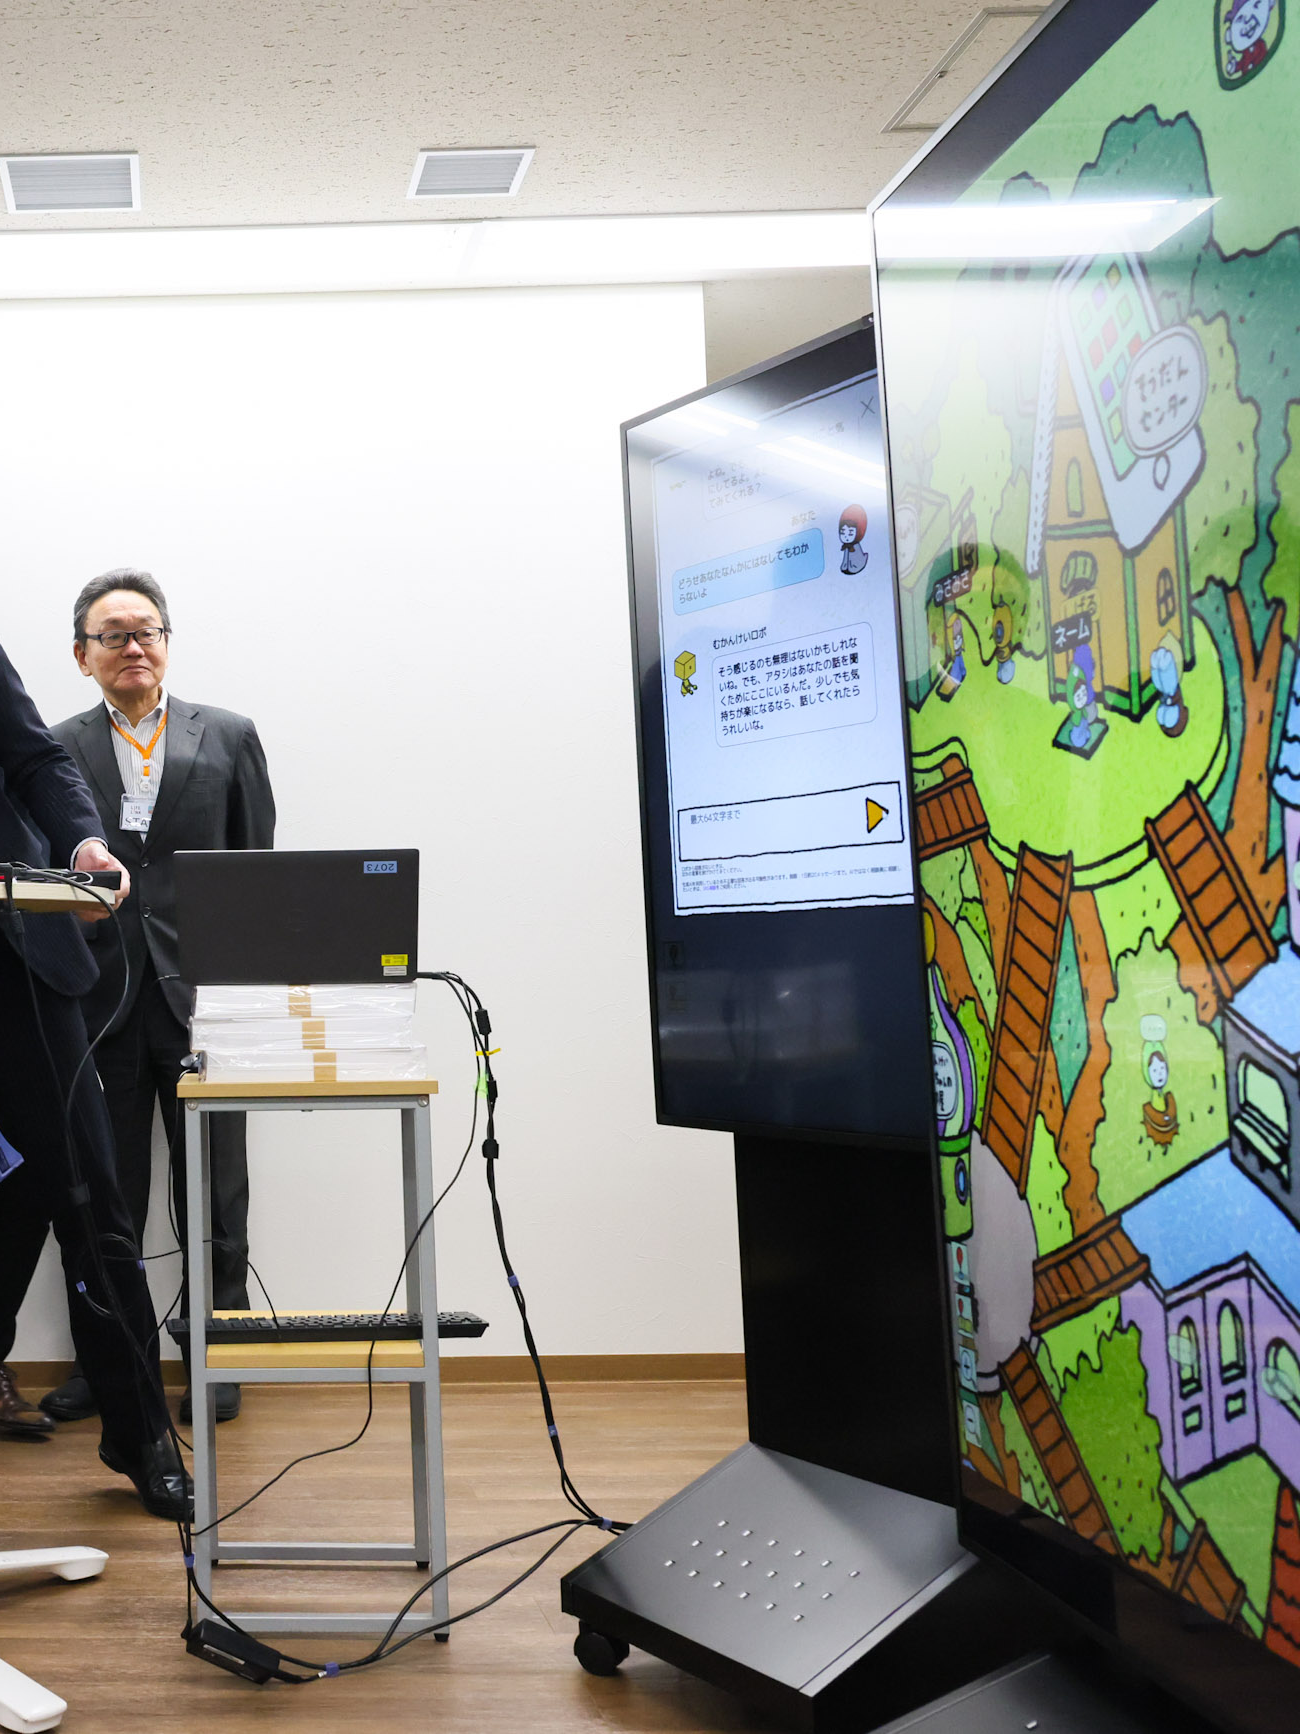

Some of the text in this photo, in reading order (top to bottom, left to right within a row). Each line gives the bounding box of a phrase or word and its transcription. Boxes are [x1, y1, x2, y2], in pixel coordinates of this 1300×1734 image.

[1134, 355, 1189, 402] そうだん
[1140, 394, 1188, 433] センター
[791, 510, 817, 527] あなた
[678, 542, 810, 590] どうせあなたなんかにはなしてもわか
[679, 587, 708, 605] らないよ
[713, 627, 767, 650] むかんけいロボ
[1054, 617, 1090, 648] ネーム
[718, 637, 858, 677] そう感じるのも無理はないかもしれな
[719, 652, 859, 692] いね。でも、アタシはあなたの話を聞
[720, 668, 860, 707] くためにここにいるんだ。少しでも気
[720, 685, 861, 722] 持ちが楽になるなら、話してくれたら
[722, 720, 764, 736] うれしいな。
[690, 809, 741, 825] 最大64文字まで
[366, 863, 395, 872] 2073
